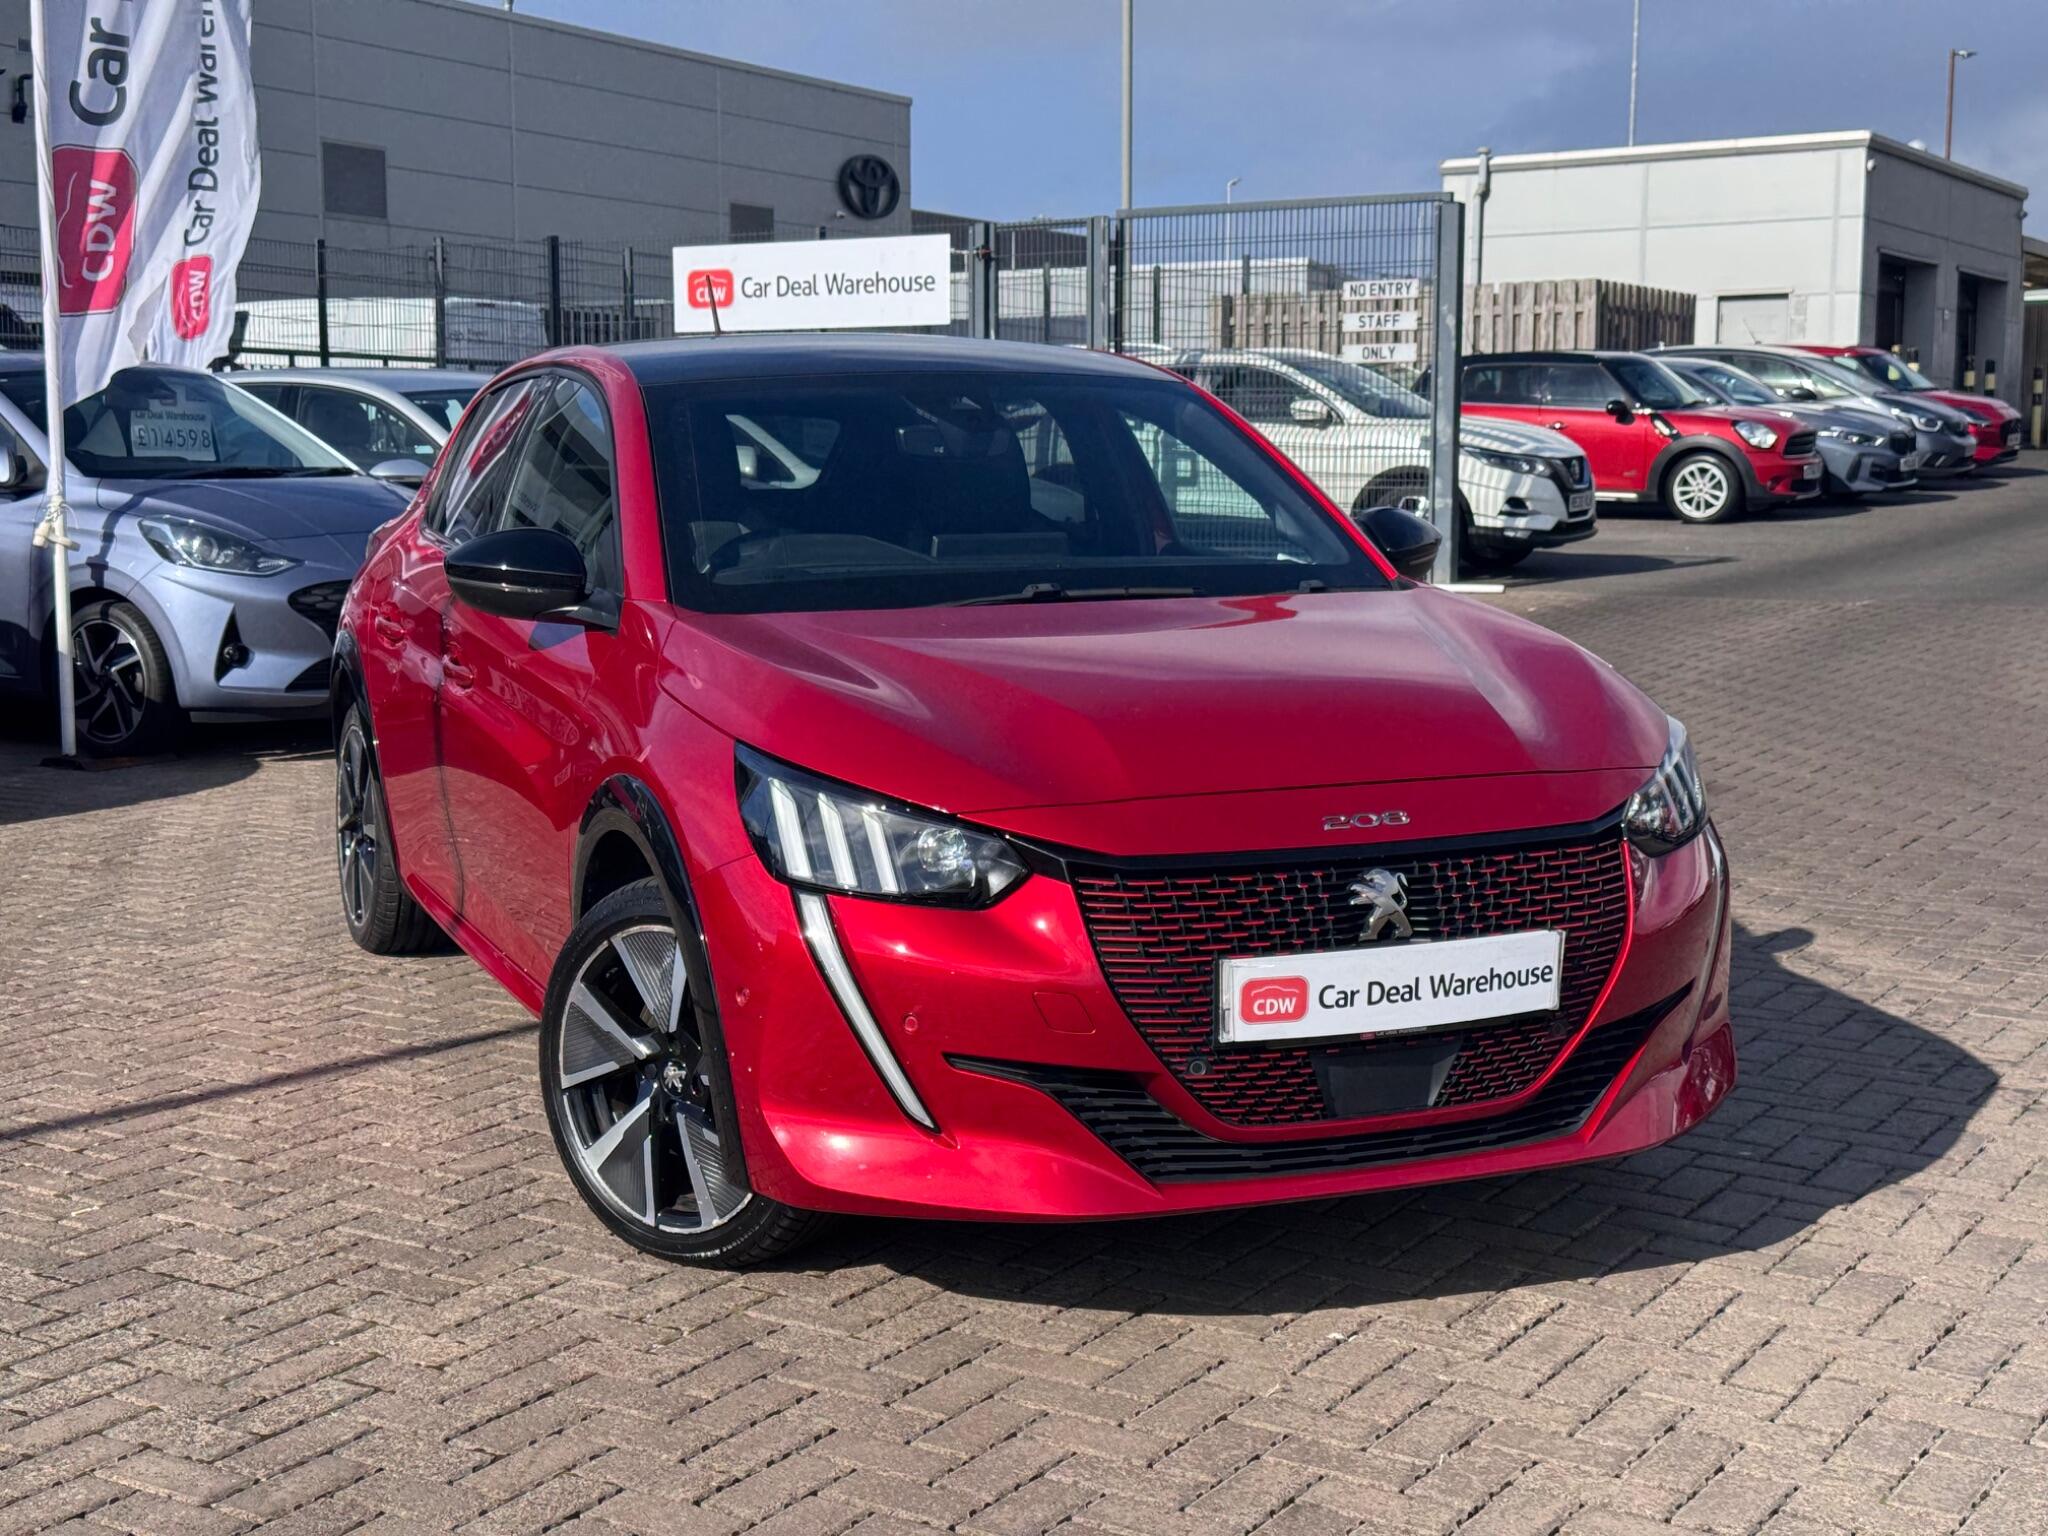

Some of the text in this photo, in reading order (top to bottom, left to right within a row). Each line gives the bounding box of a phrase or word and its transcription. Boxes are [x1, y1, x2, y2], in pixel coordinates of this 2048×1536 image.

[68, 17, 130, 282] CDW Car
[187, 117, 219, 193] Deal
[184, 200, 216, 247] Car
[188, 269, 207, 321] CDW
[741, 276, 771, 299] Car
[776, 274, 819, 298] Deal
[824, 271, 936, 295] Warehouse
[1349, 281, 1412, 297] NO ENTRY
[1358, 313, 1401, 328] STAFF
[1362, 345, 1396, 360] ONLY
[138, 428, 211, 448] £14598
[1321, 809, 1411, 832] 208
[1252, 963, 1554, 1017] CDW Car Deal Warehouse
